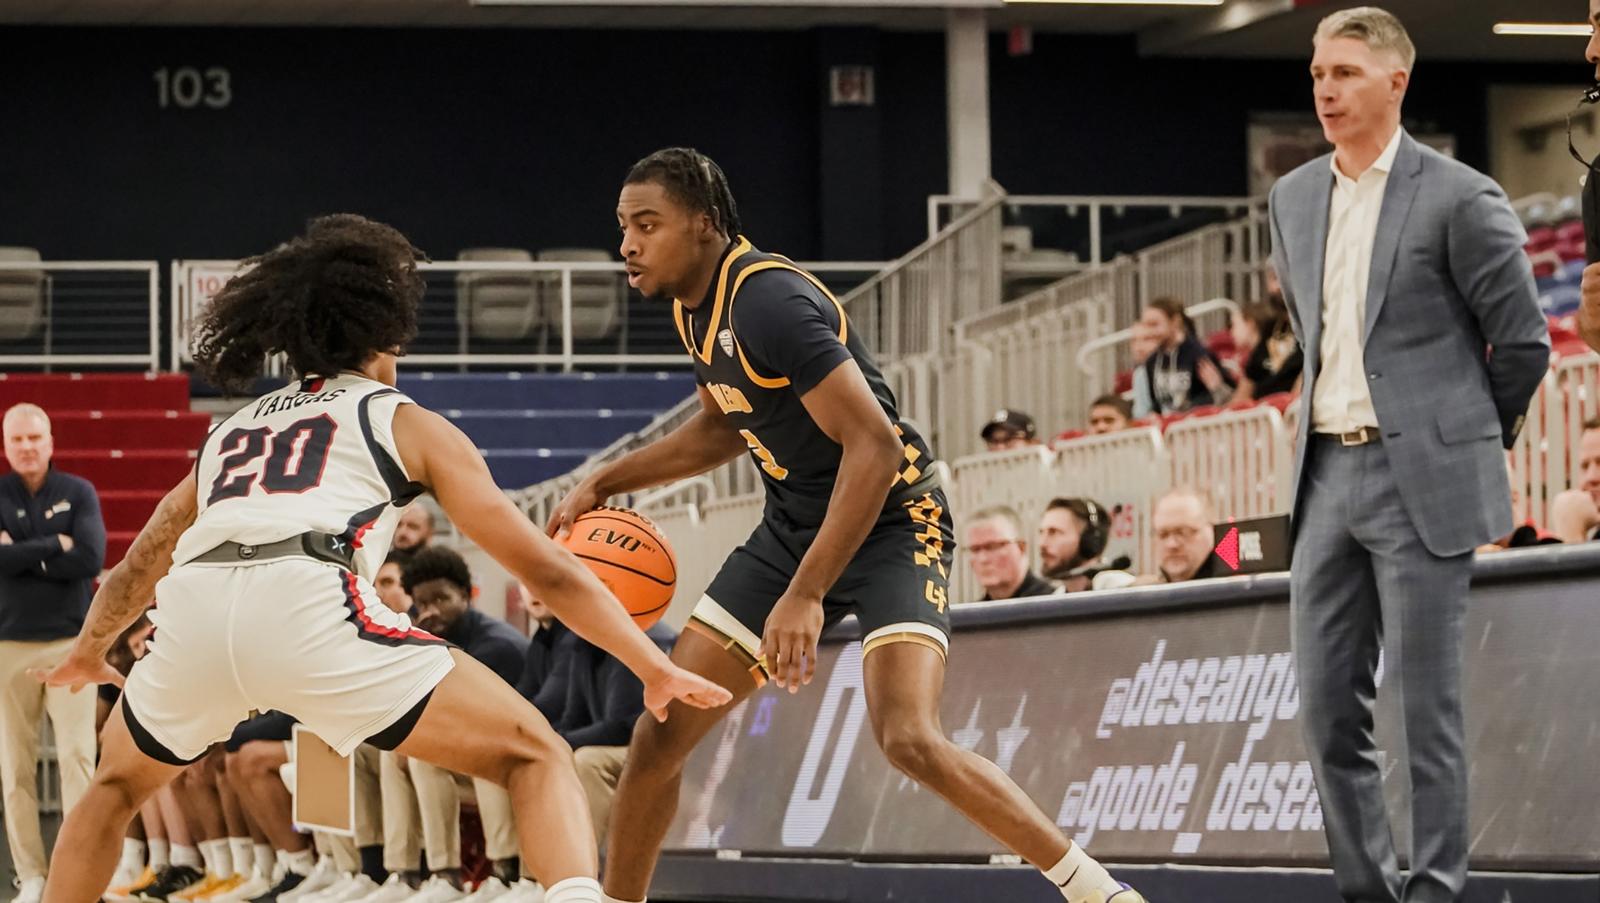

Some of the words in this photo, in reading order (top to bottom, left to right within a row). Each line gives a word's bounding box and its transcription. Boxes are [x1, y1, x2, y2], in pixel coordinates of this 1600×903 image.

[153, 66, 231, 108] 103
[207, 412, 338, 507] 20
[588, 528, 641, 552] EVO
